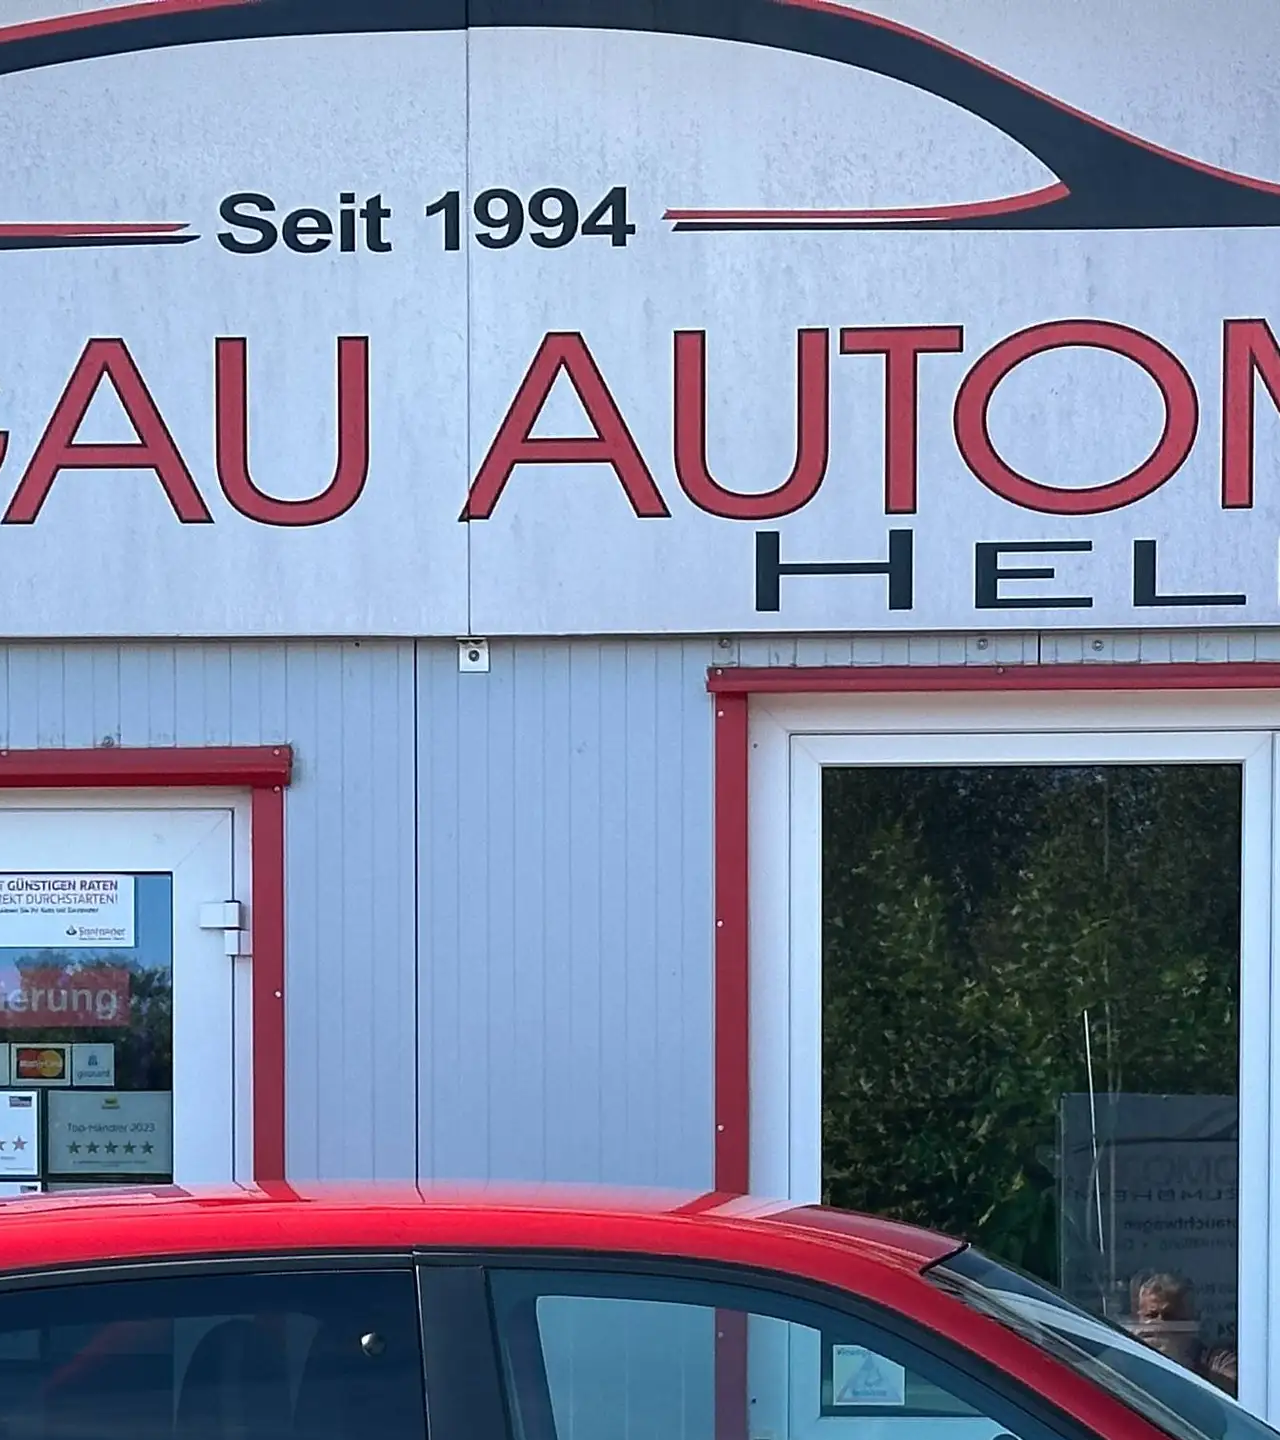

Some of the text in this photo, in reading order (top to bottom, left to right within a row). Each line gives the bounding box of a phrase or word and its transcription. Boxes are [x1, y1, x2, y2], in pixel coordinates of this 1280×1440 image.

[216, 186, 636, 254] Seit 1994
[7, 877, 76, 892] GÜNSTIGEN
[79, 880, 118, 892] RATEN
[25, 893, 118, 905] DURCHSTARTEN!
